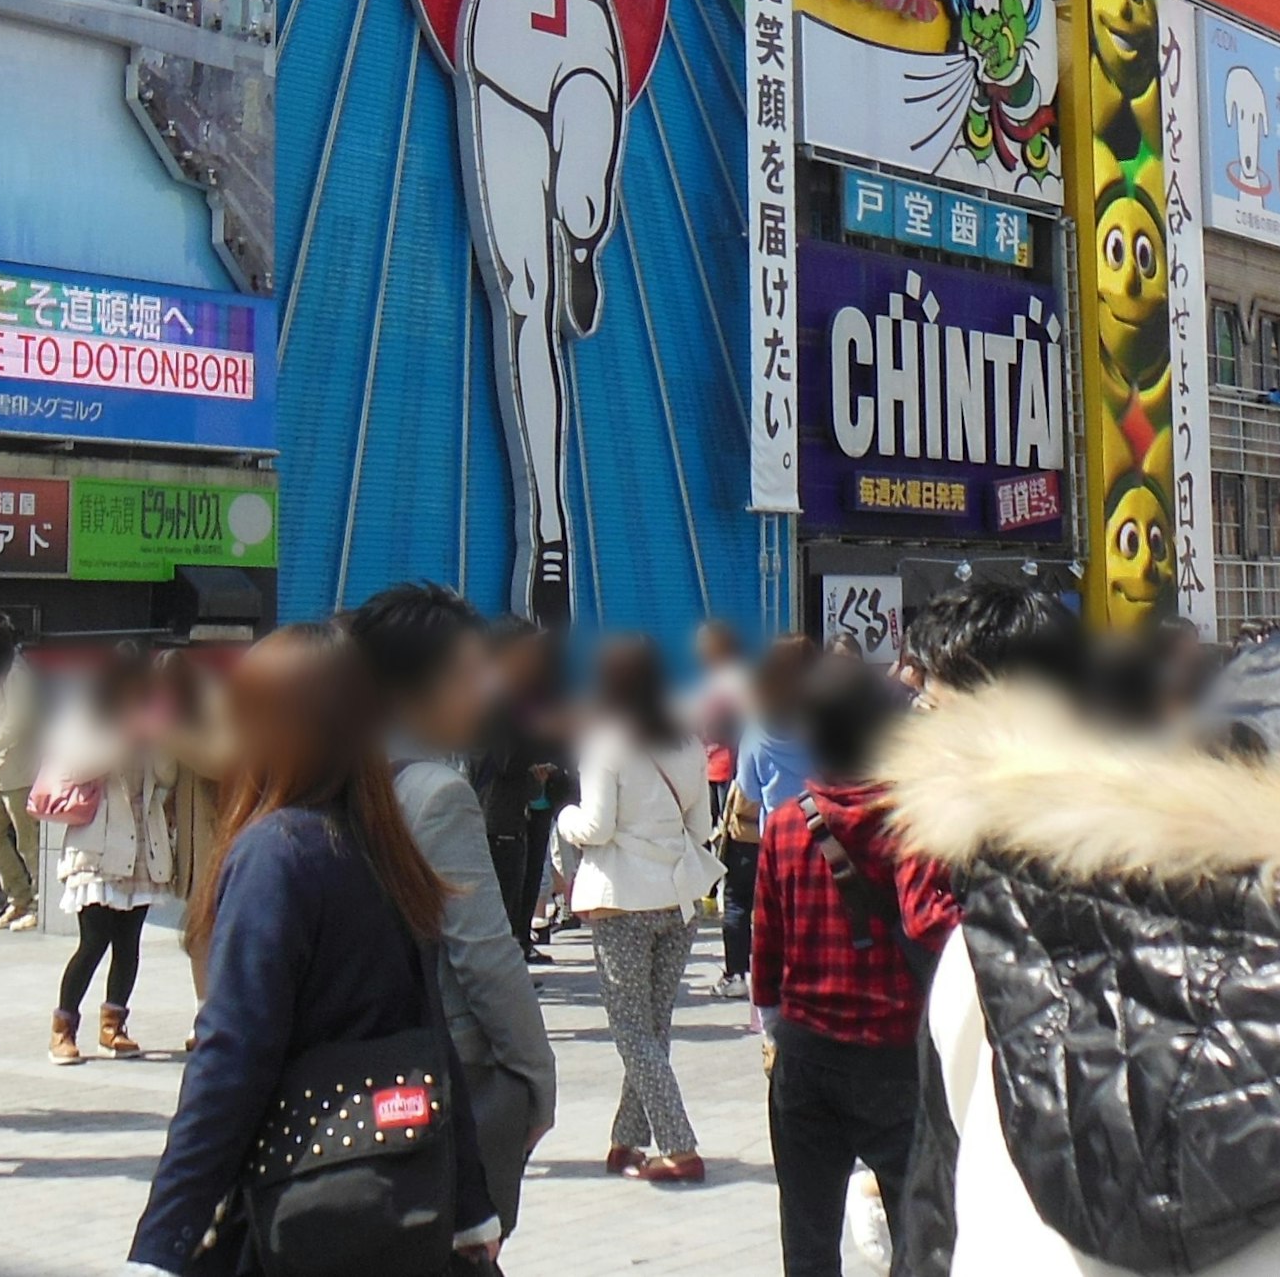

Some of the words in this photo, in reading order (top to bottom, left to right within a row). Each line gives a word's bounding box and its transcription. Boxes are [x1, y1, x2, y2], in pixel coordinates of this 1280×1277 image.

[855, 178, 1024, 256] 戸堂歯科
[1157, 25, 1207, 615] 力を合わせよう日本
[17, 334, 61, 377] TO
[72, 339, 250, 396] DOTONBORI
[831, 270, 1064, 471] CHINTAI
[141, 488, 224, 541] ピタットハウス
[858, 475, 966, 512] 毎週水曜日発売
